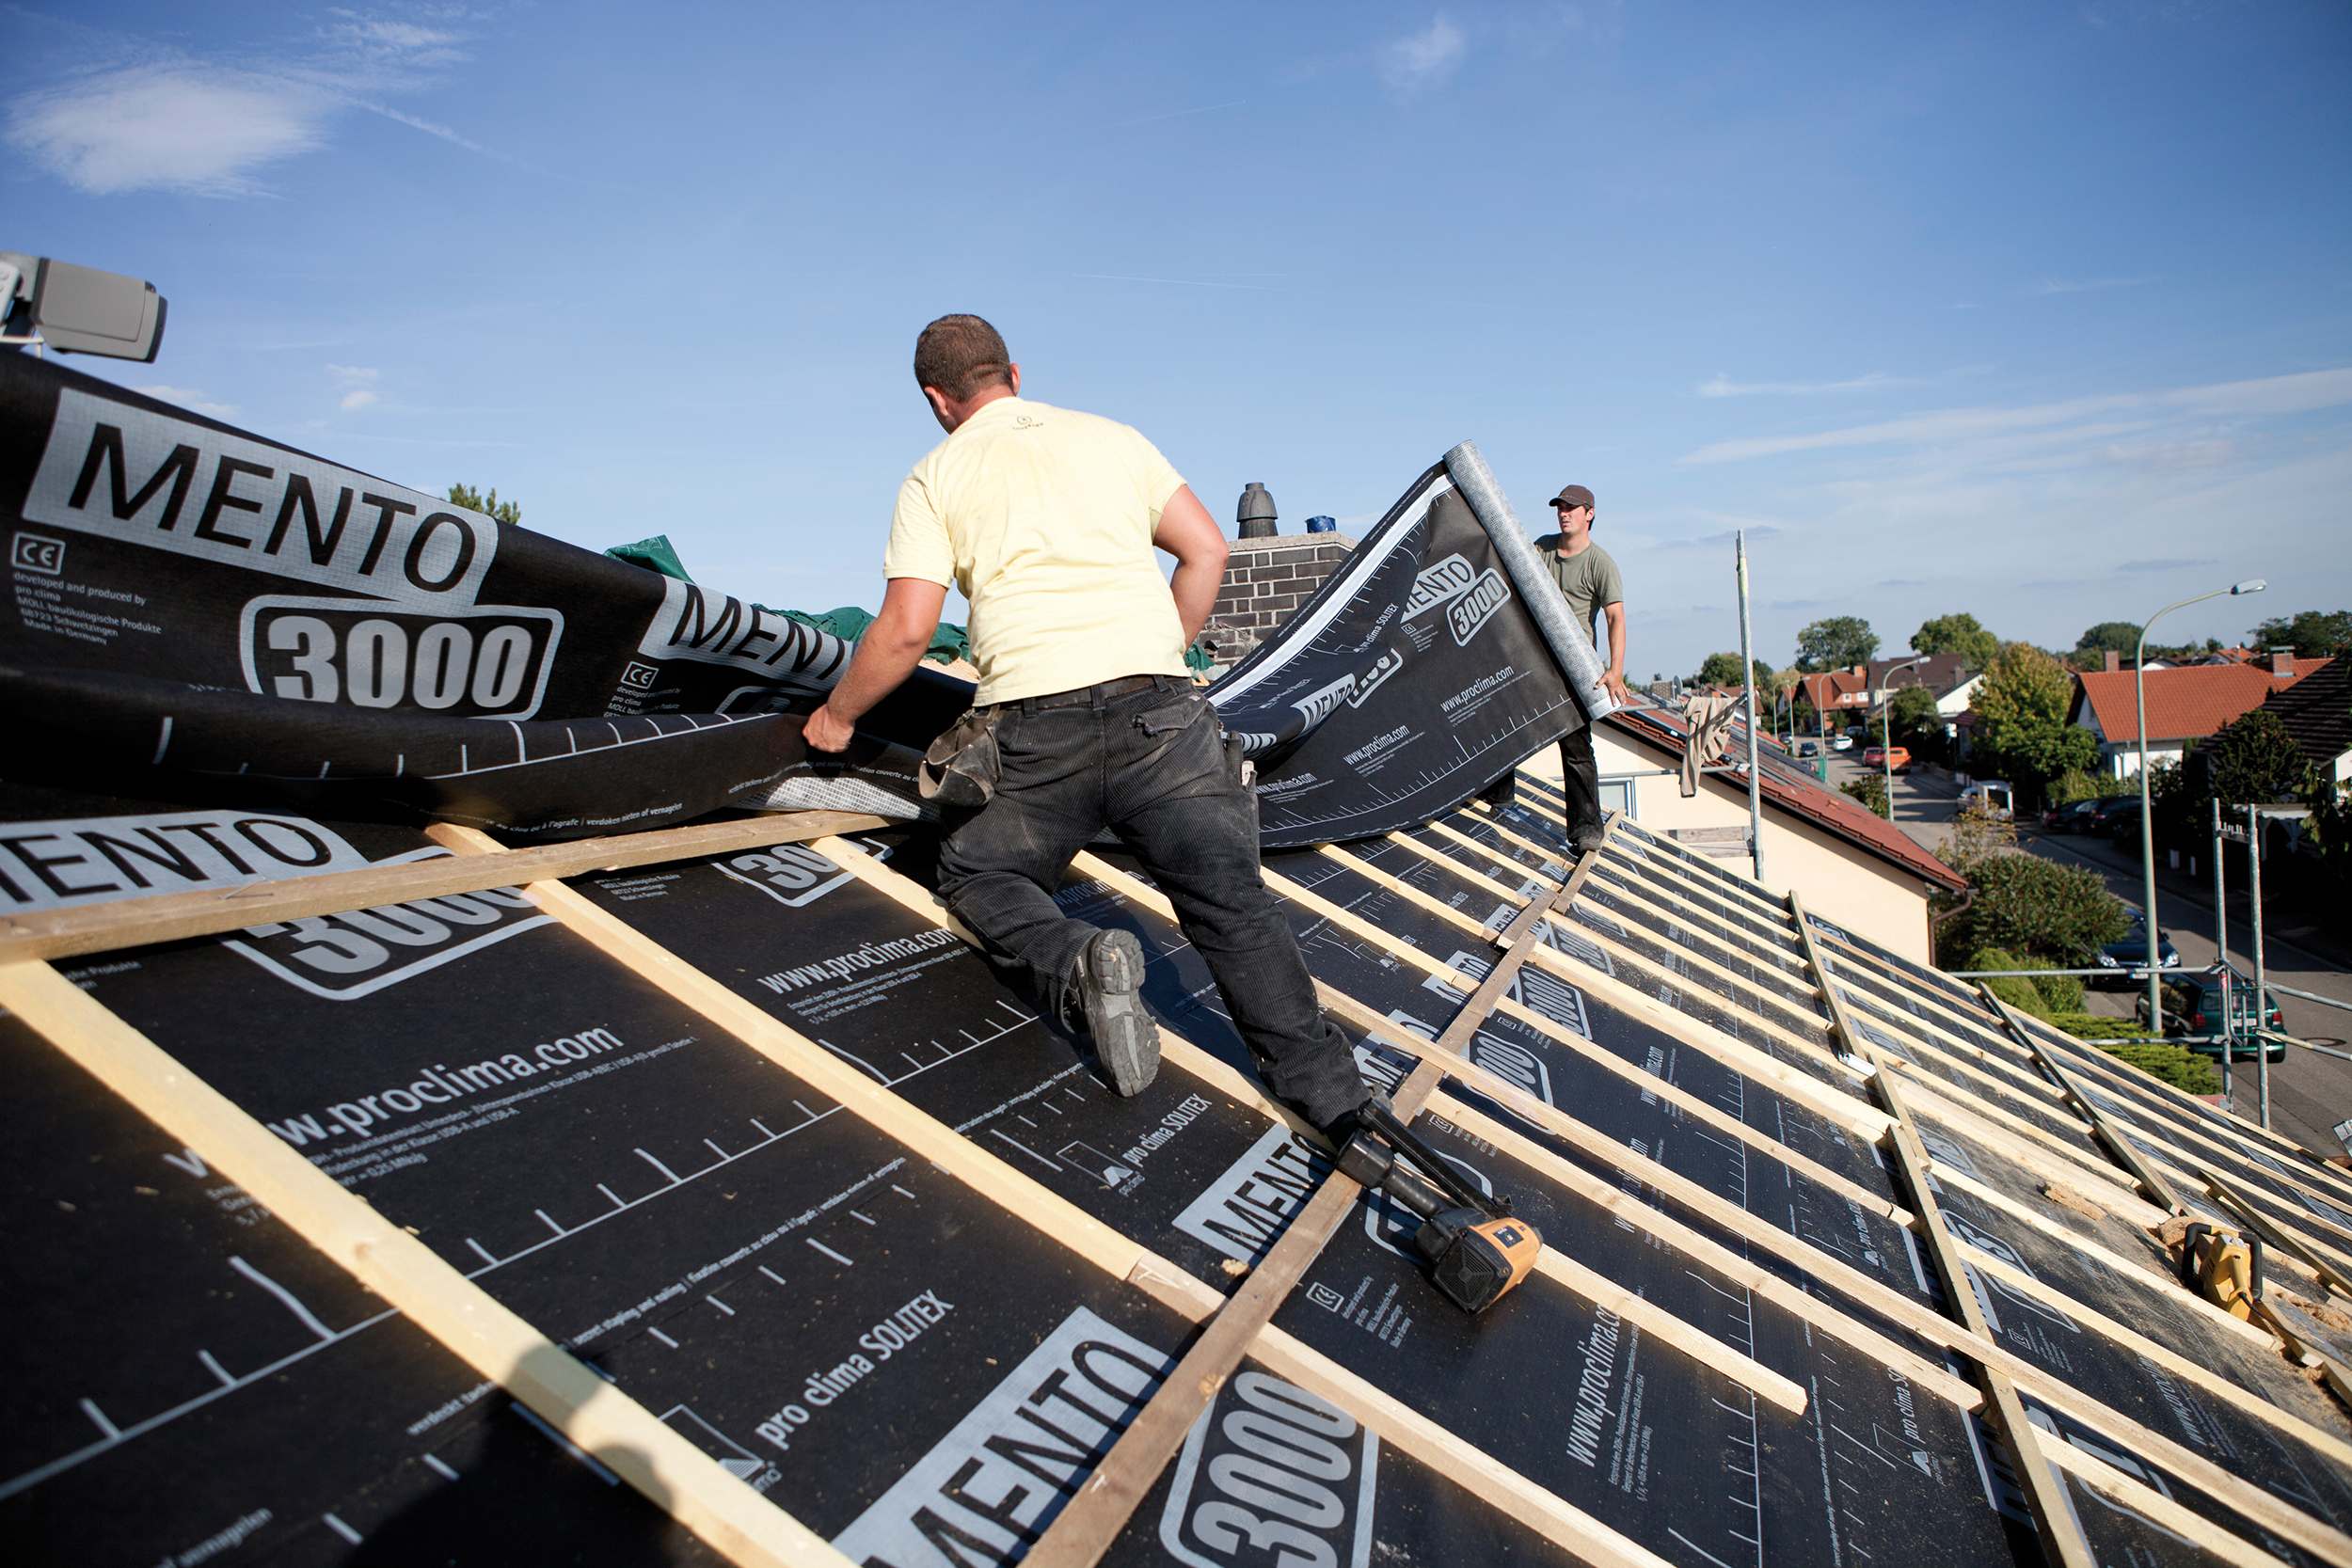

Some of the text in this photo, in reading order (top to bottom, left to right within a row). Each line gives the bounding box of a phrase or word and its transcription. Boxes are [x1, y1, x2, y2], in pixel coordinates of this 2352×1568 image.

[68, 422, 477, 594] MENTO
[13, 572, 147, 607] developed and produced by
[15, 585, 61, 602] pro clima
[1454, 576, 1503, 636] 3000
[16, 595, 162, 635] MOLL bauökologische Produkte
[24, 618, 107, 646] Made in Germany
[54, 614, 119, 637] Schwetzingen
[1375, 602, 1399, 626] SOLITEX
[267, 615, 532, 710] 3000
[629, 669, 653, 685] CE
[1439, 665, 1515, 713] www.proclima.com
[1343, 724, 1411, 766] www.proclima.com
[876, 768, 902, 779] couverte
[641, 808, 650, 817] of
[1122, 1092, 1213, 1168] pro clima SOLITEX
[601, 1307, 643, 1331] stapling
[636, 1295, 658, 1314] and
[654, 1281, 689, 1305] nailing
[750, 1239, 763, 1252] au
[760, 1230, 780, 1245] clou
[776, 1224, 790, 1235] ou
[755, 1288, 955, 1451] pro clima SOLITEX
[1893, 1386, 1915, 1419] clima
[1902, 1418, 1926, 1445] pro
[1191, 1370, 1359, 1568] 3000
